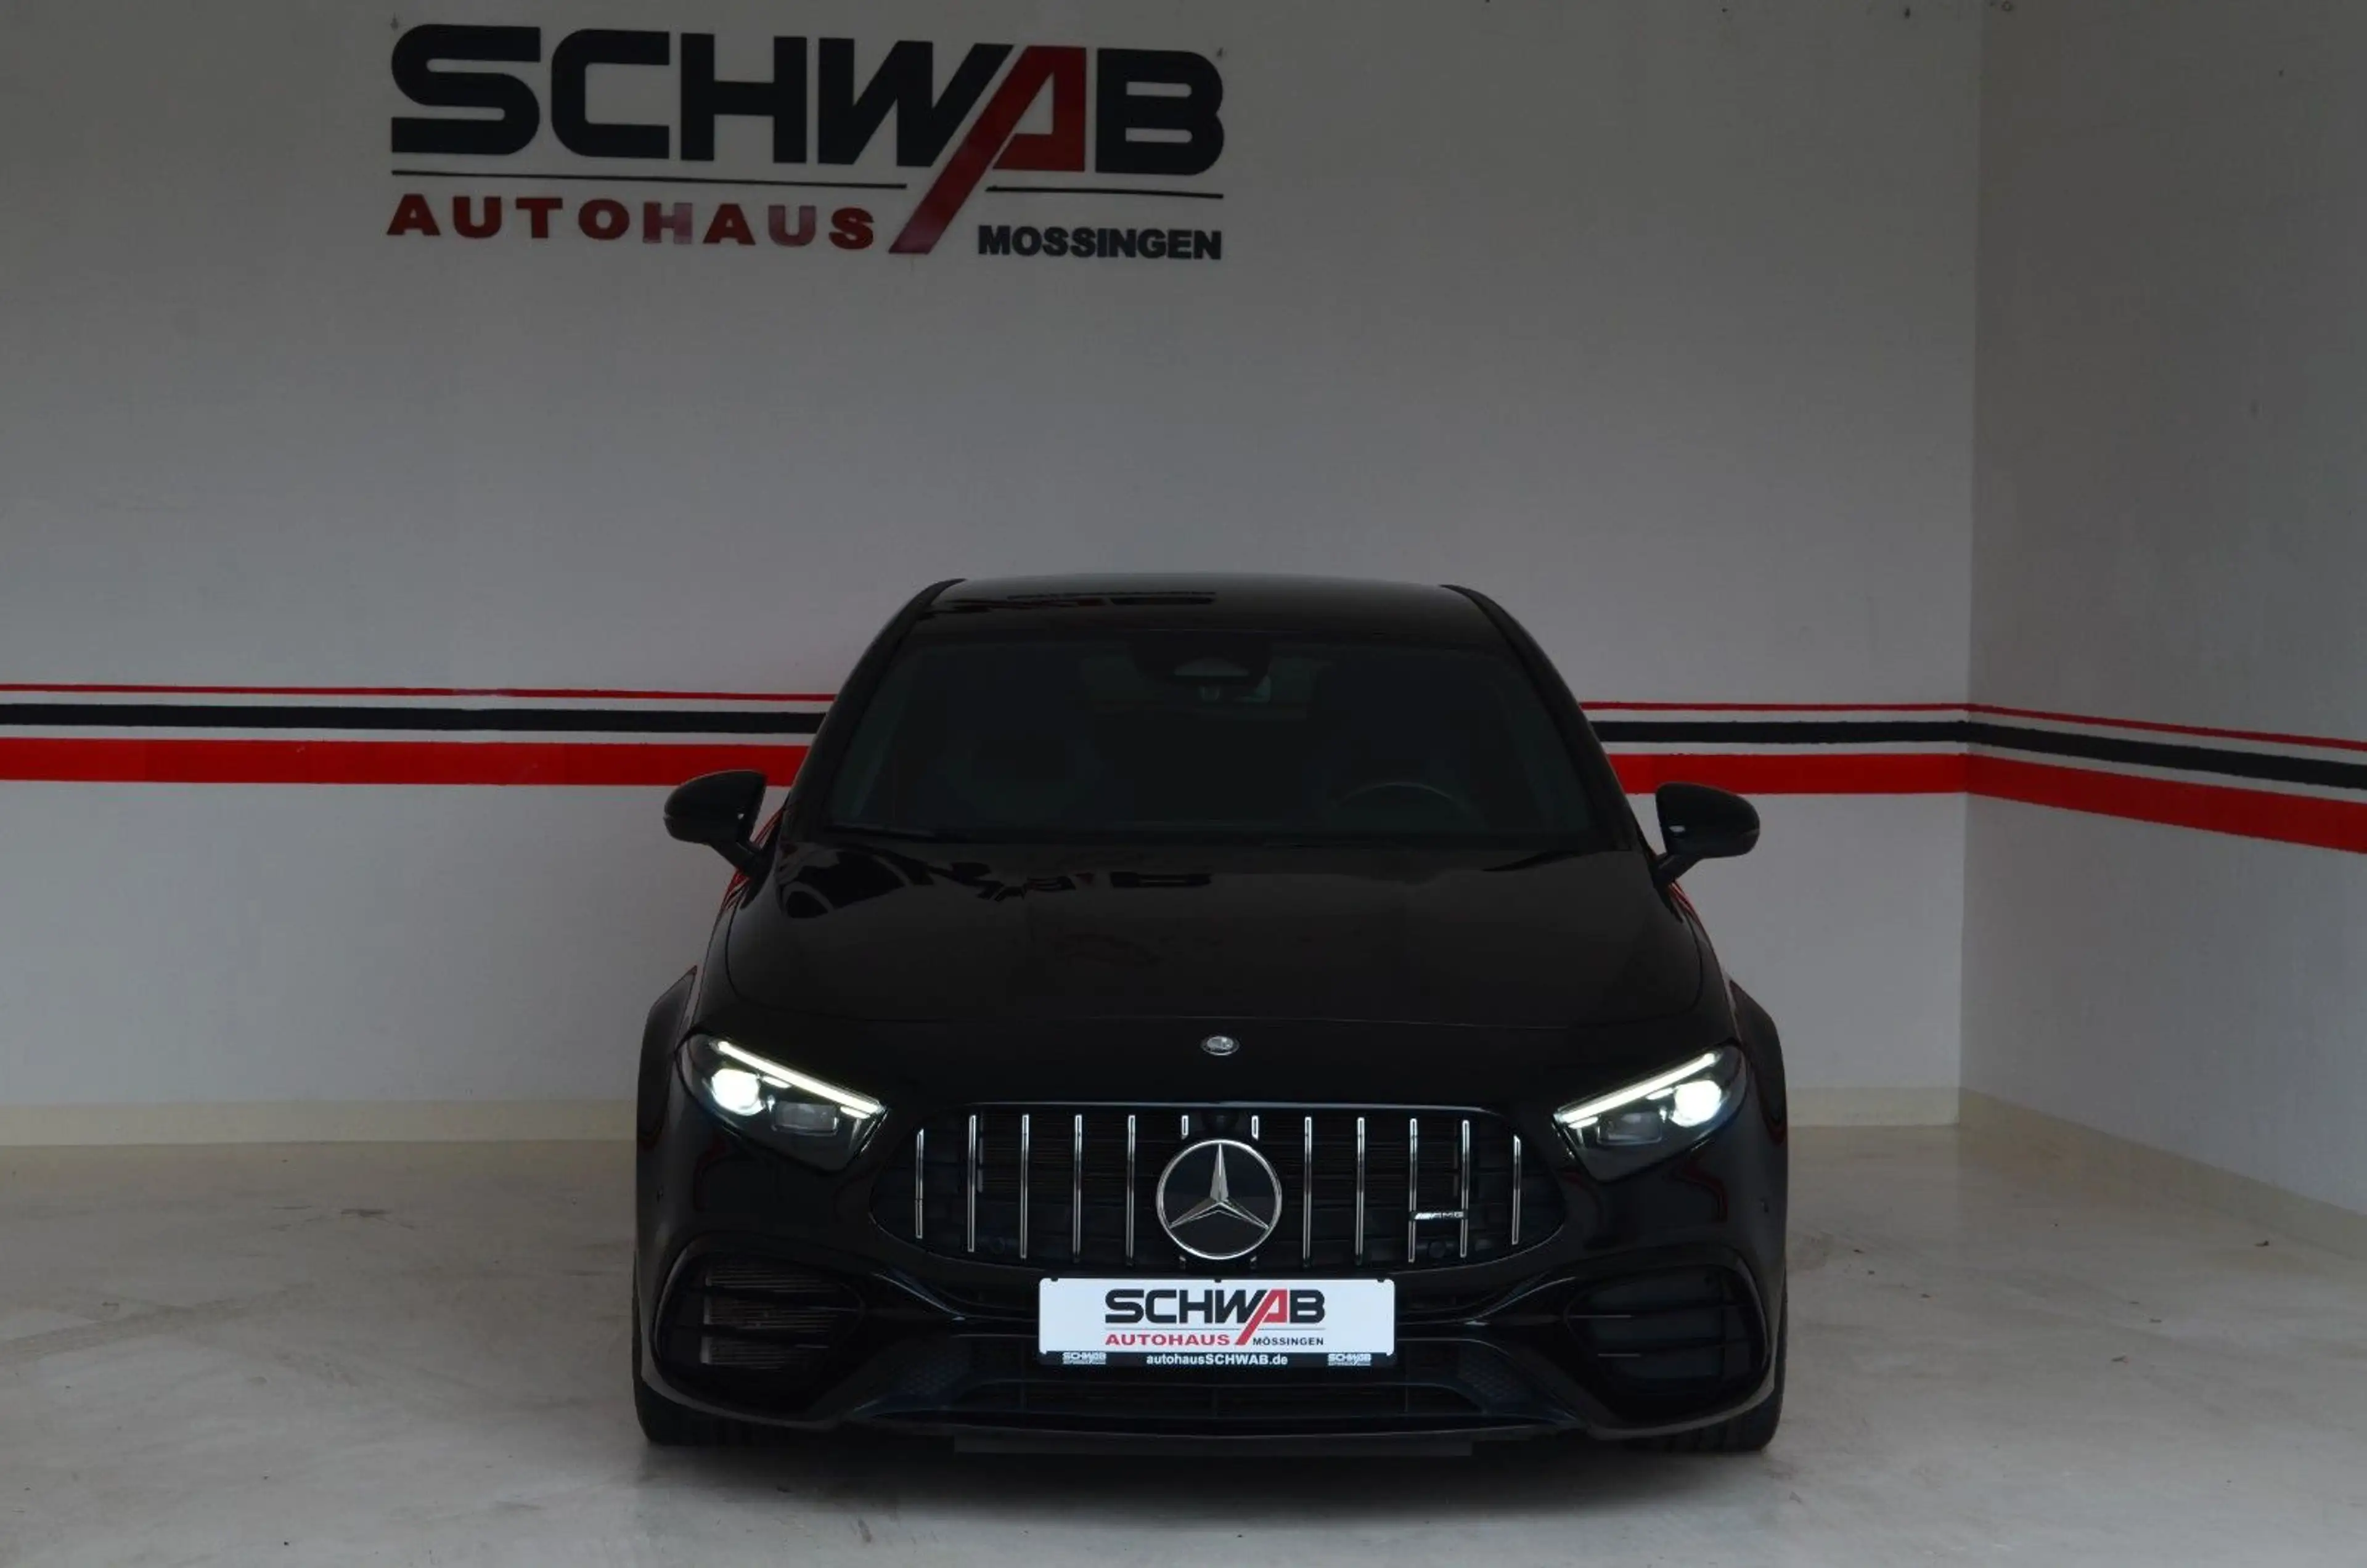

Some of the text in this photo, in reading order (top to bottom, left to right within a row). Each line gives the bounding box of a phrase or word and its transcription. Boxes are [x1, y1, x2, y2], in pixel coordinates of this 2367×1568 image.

[391, 23, 1225, 254] SCHWAB
[386, 193, 875, 250] AUTOHAUS
[978, 224, 1223, 260] MOSSINGEN
[1105, 1289, 1326, 1345] SCHWAB
[1106, 1334, 1230, 1346] AUTOHAUS
[1253, 1336, 1324, 1346] MÖSSINGEN
[1146, 1354, 1288, 1366] autohausSCHWAB.de
